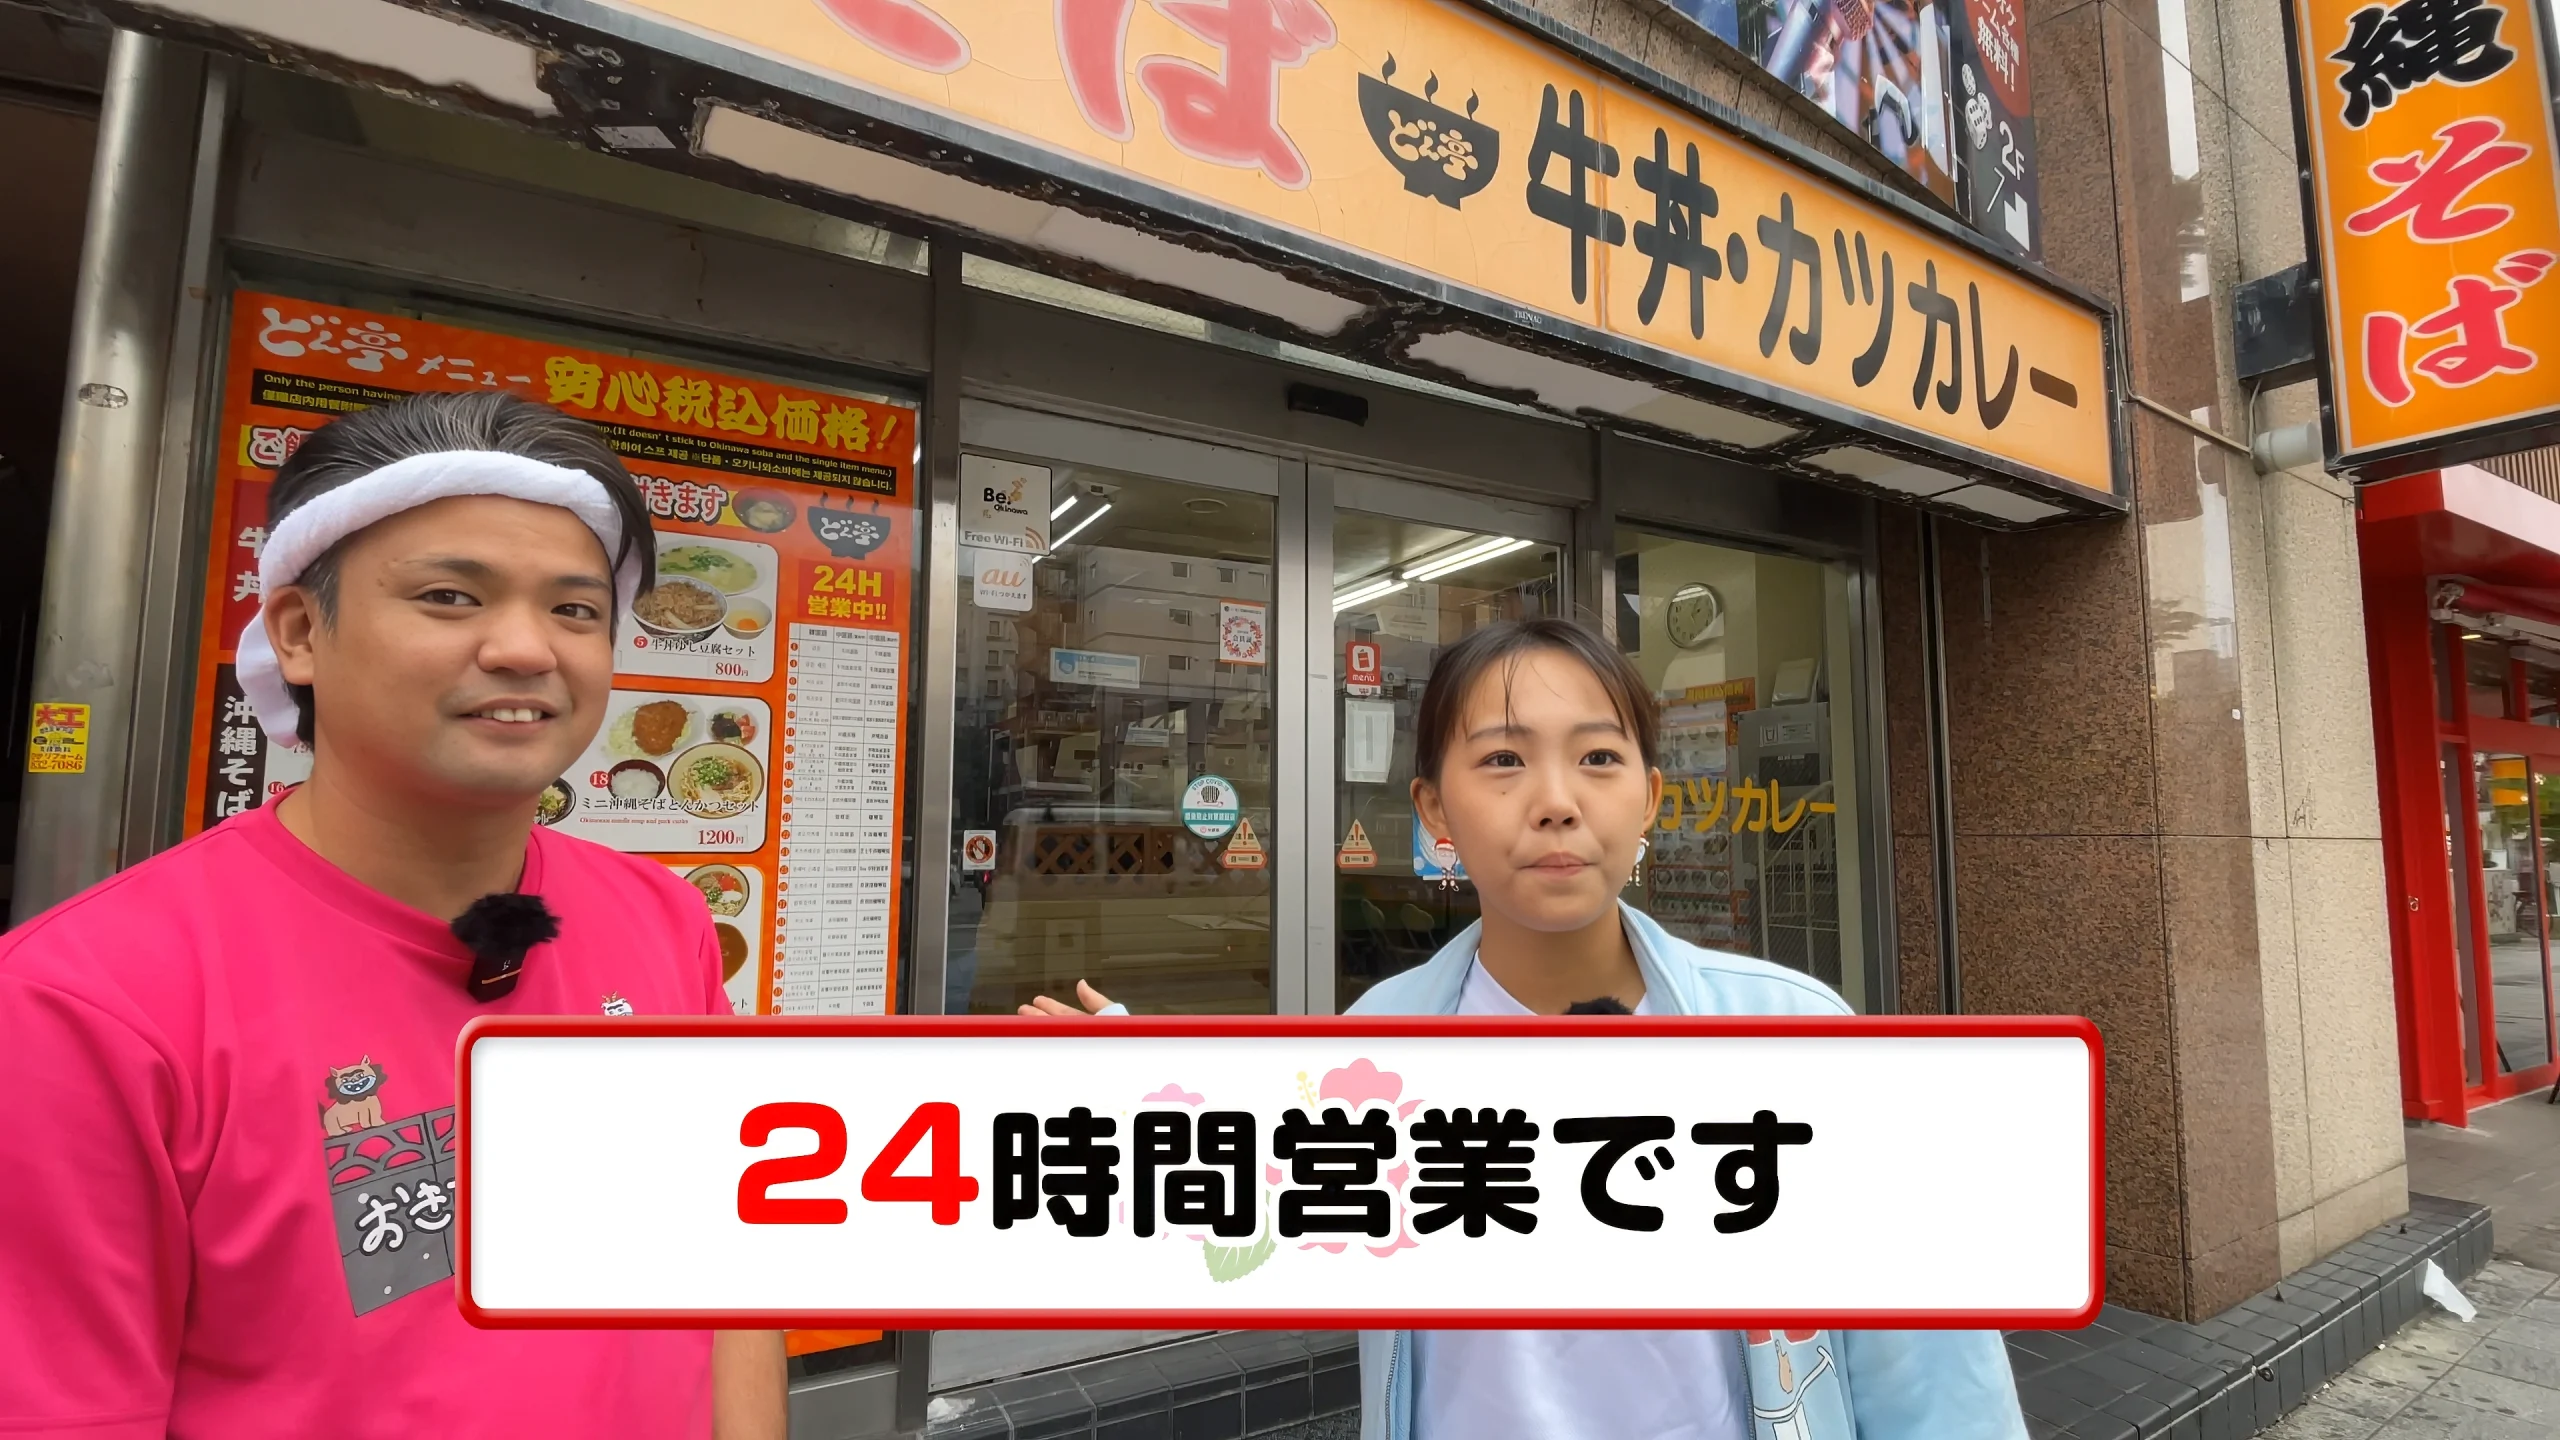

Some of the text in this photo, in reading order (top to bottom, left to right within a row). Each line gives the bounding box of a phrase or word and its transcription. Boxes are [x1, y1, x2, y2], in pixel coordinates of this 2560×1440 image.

[1388, 108, 1478, 181] どん亭
[1999, 121, 2025, 181] 2F
[1526, 82, 2079, 431] 牛丼・カツカレー
[259, 307, 408, 372] どん亭
[417, 355, 531, 387] メニュー
[264, 374, 292, 387] Only
[296, 377, 316, 389] the
[318, 382, 359, 396] person
[672, 436, 695, 446] stick
[697, 439, 707, 448] to
[709, 441, 750, 454] Okinawa
[752, 448, 774, 458] soba
[776, 451, 793, 461] and
[795, 454, 810, 464] the
[812, 457, 838, 469] single
[840, 462, 860, 472] item
[964, 530, 1024, 548] Free Wi-Fi
[813, 565, 883, 598] 24H
[981, 567, 1027, 588] au
[593, 773, 609, 786] 18
[356, 1179, 455, 1254] おき
